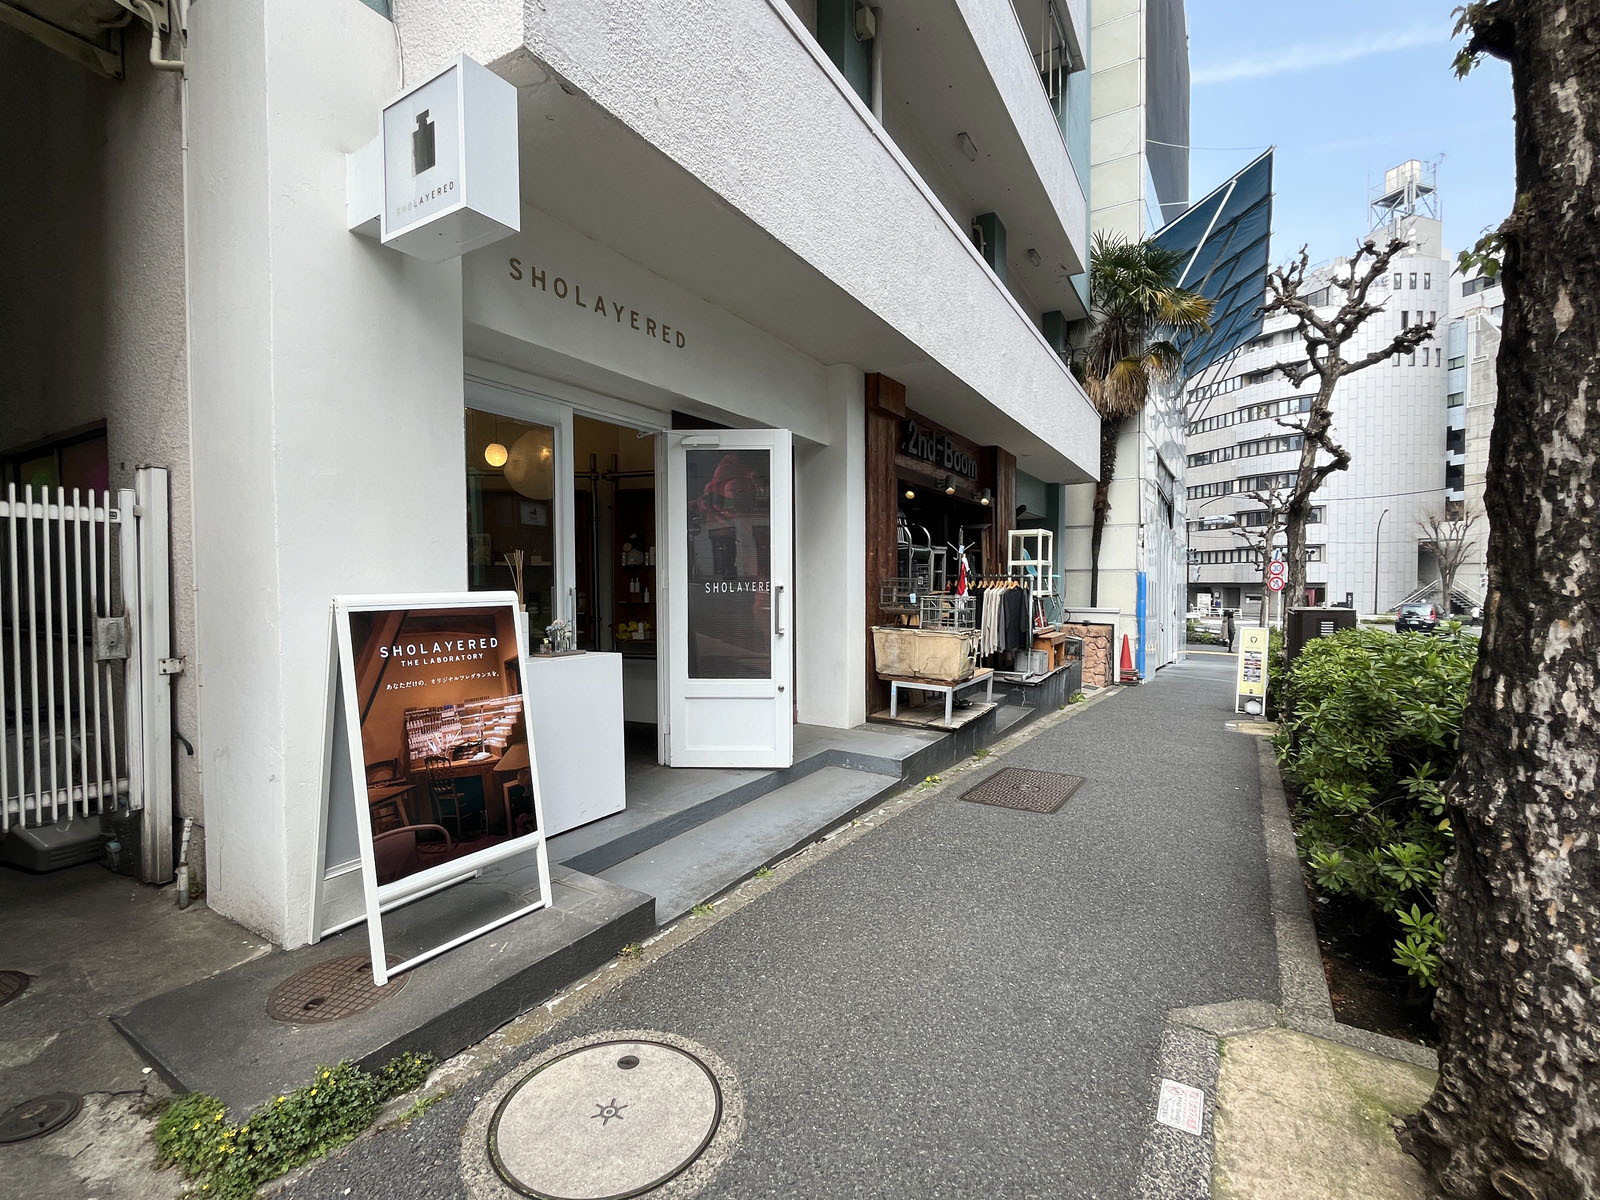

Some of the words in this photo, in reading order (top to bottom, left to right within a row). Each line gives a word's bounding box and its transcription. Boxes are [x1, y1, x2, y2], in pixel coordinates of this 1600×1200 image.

[509, 257, 686, 349] SHOLAYERED
[908, 420, 977, 479] 2nd-Boom
[705, 581, 771, 594] SHOLAYERE
[379, 637, 499, 658] SHOLAYERED
[400, 660, 420, 668] THE
[423, 653, 484, 666] LABORATORY
